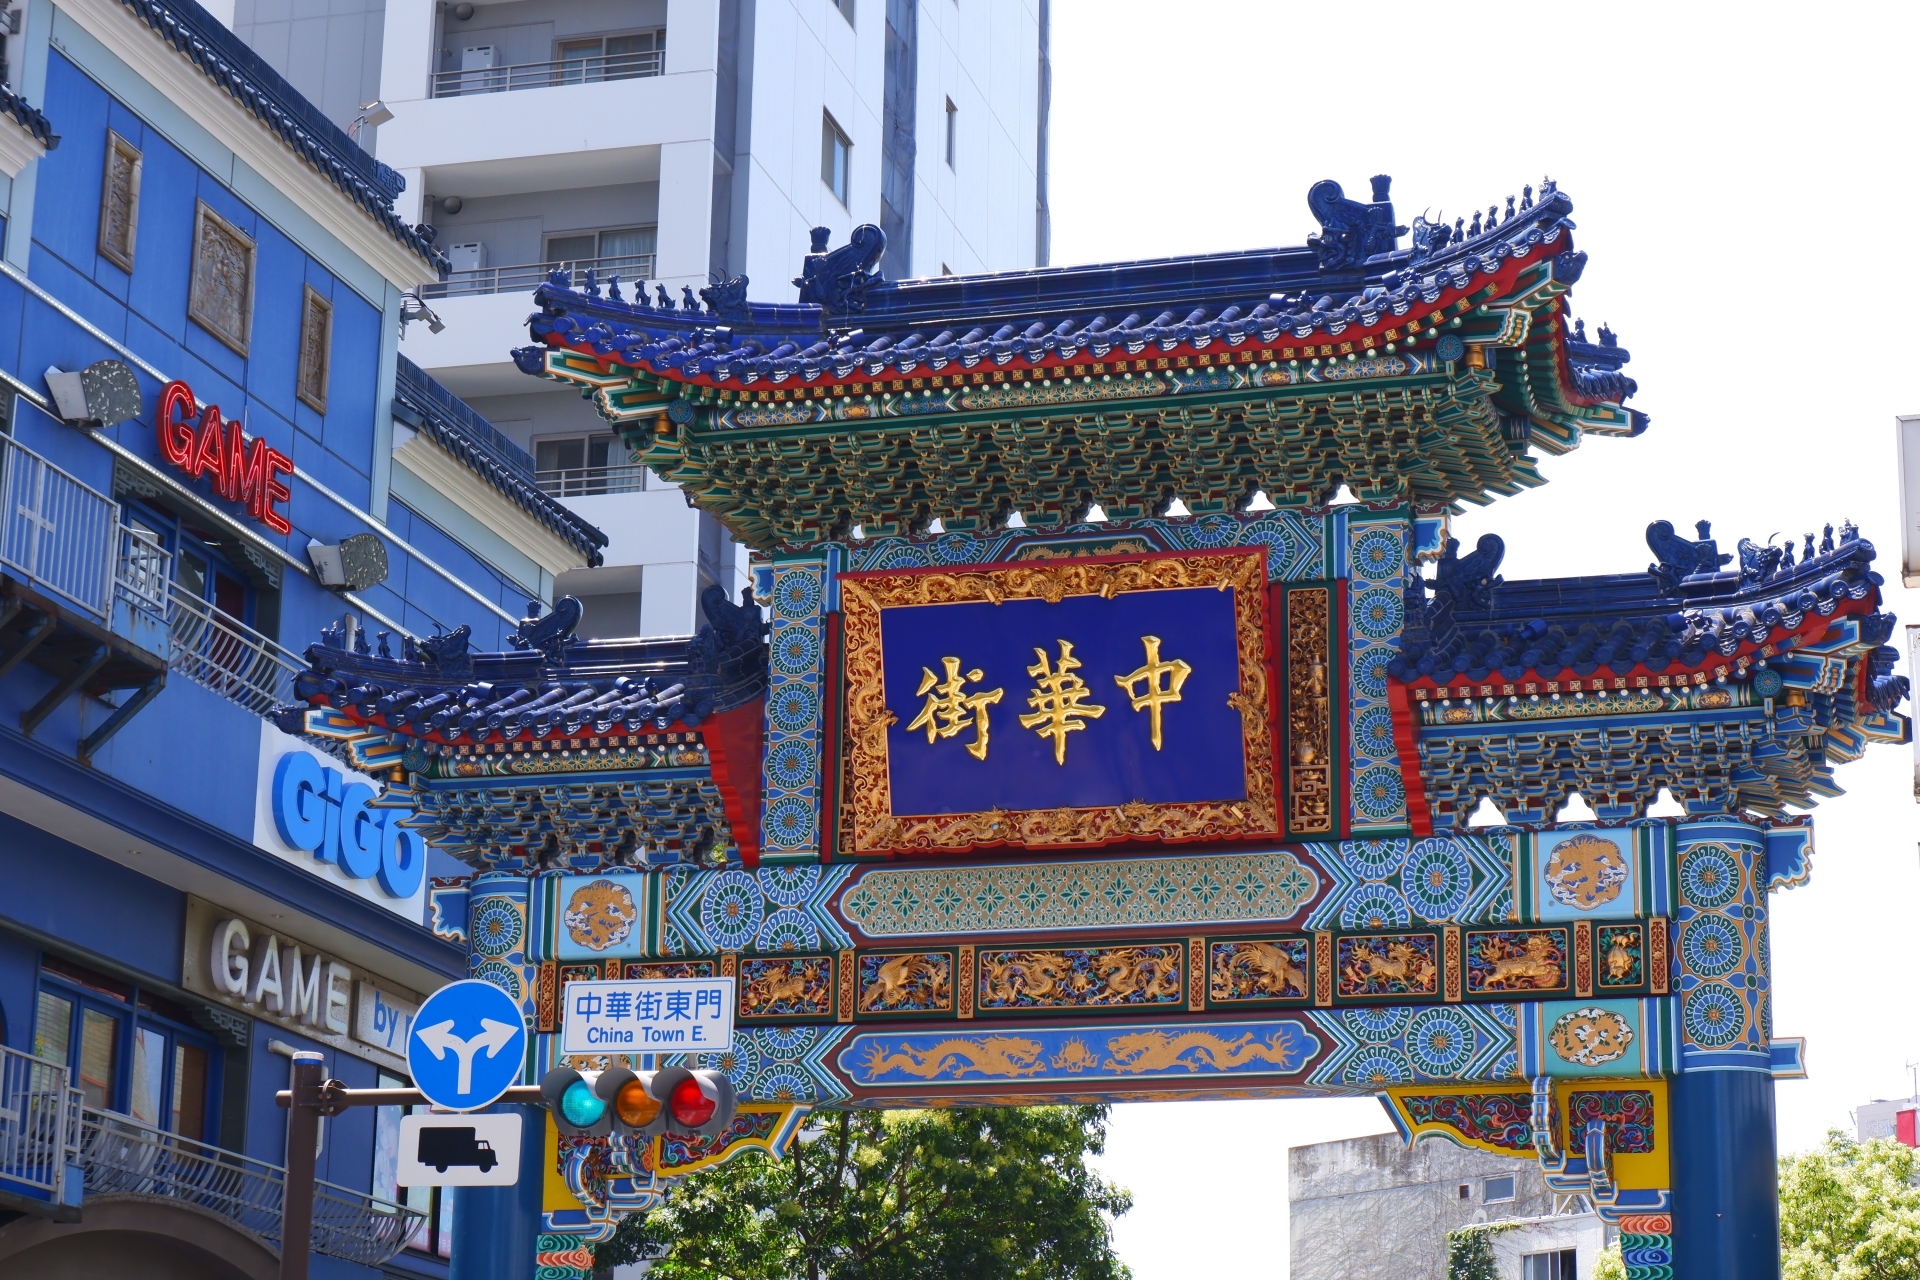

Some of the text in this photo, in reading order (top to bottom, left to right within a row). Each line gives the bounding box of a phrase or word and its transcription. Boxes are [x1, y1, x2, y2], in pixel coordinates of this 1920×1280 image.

[157, 380, 294, 536] GAME
[272, 751, 424, 899] GiGO
[211, 919, 351, 1035] GAME
[373, 990, 400, 1048] by
[576, 989, 722, 1023] 中華街東門
[587, 1025, 707, 1044] China Town E.
